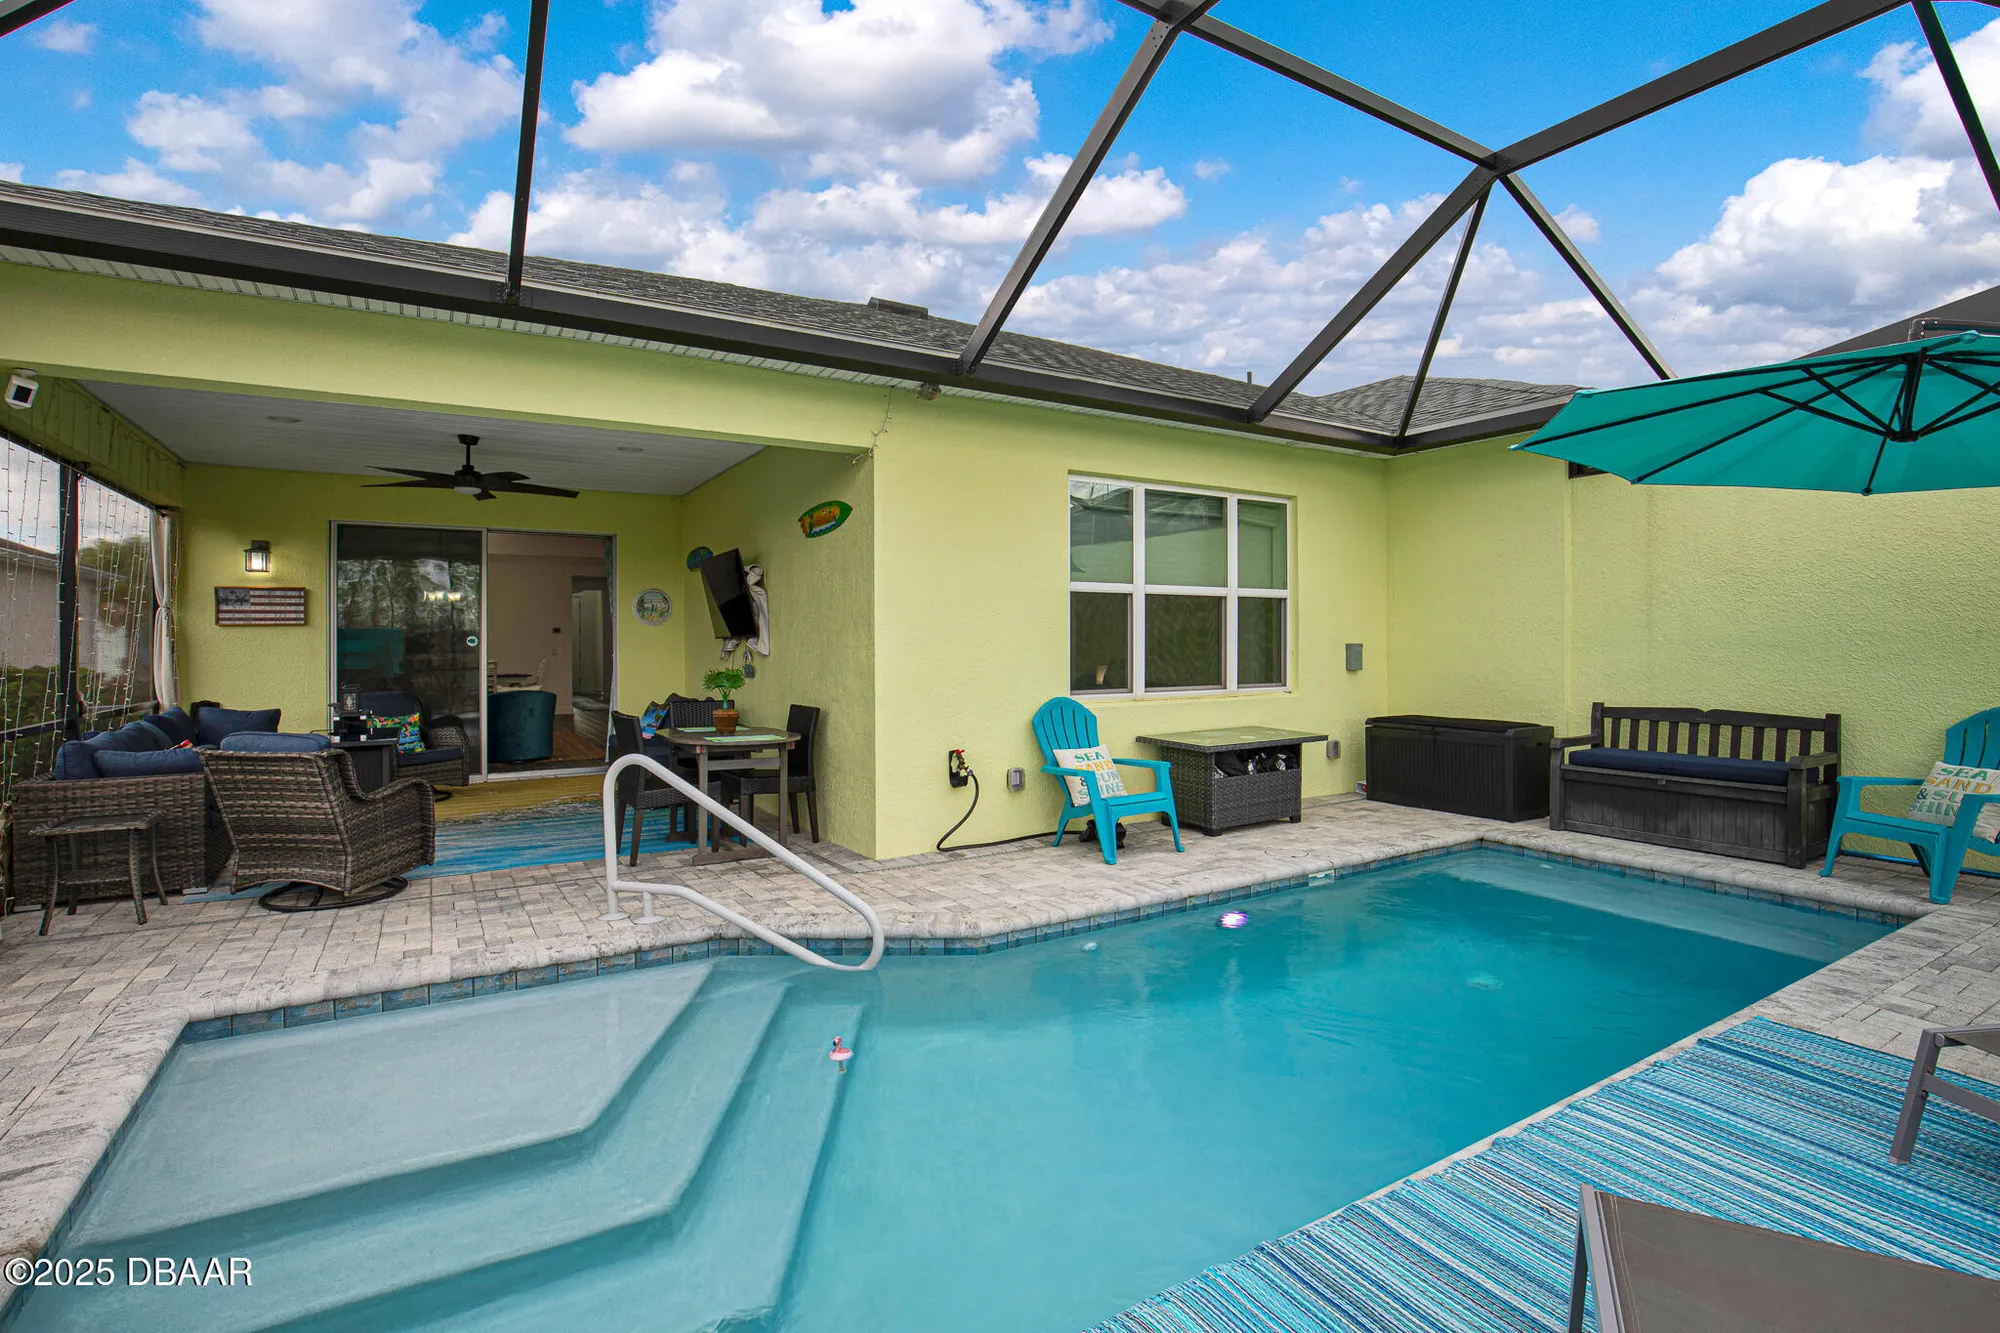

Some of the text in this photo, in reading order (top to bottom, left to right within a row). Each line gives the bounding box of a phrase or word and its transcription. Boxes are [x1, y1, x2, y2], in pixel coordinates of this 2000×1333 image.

[1074, 751, 1105, 763] SEA
[1937, 768, 1988, 781] SEA
[1927, 776, 1993, 794] SAND
[1916, 788, 1929, 800] &
[1908, 800, 1961, 817] SHIN
